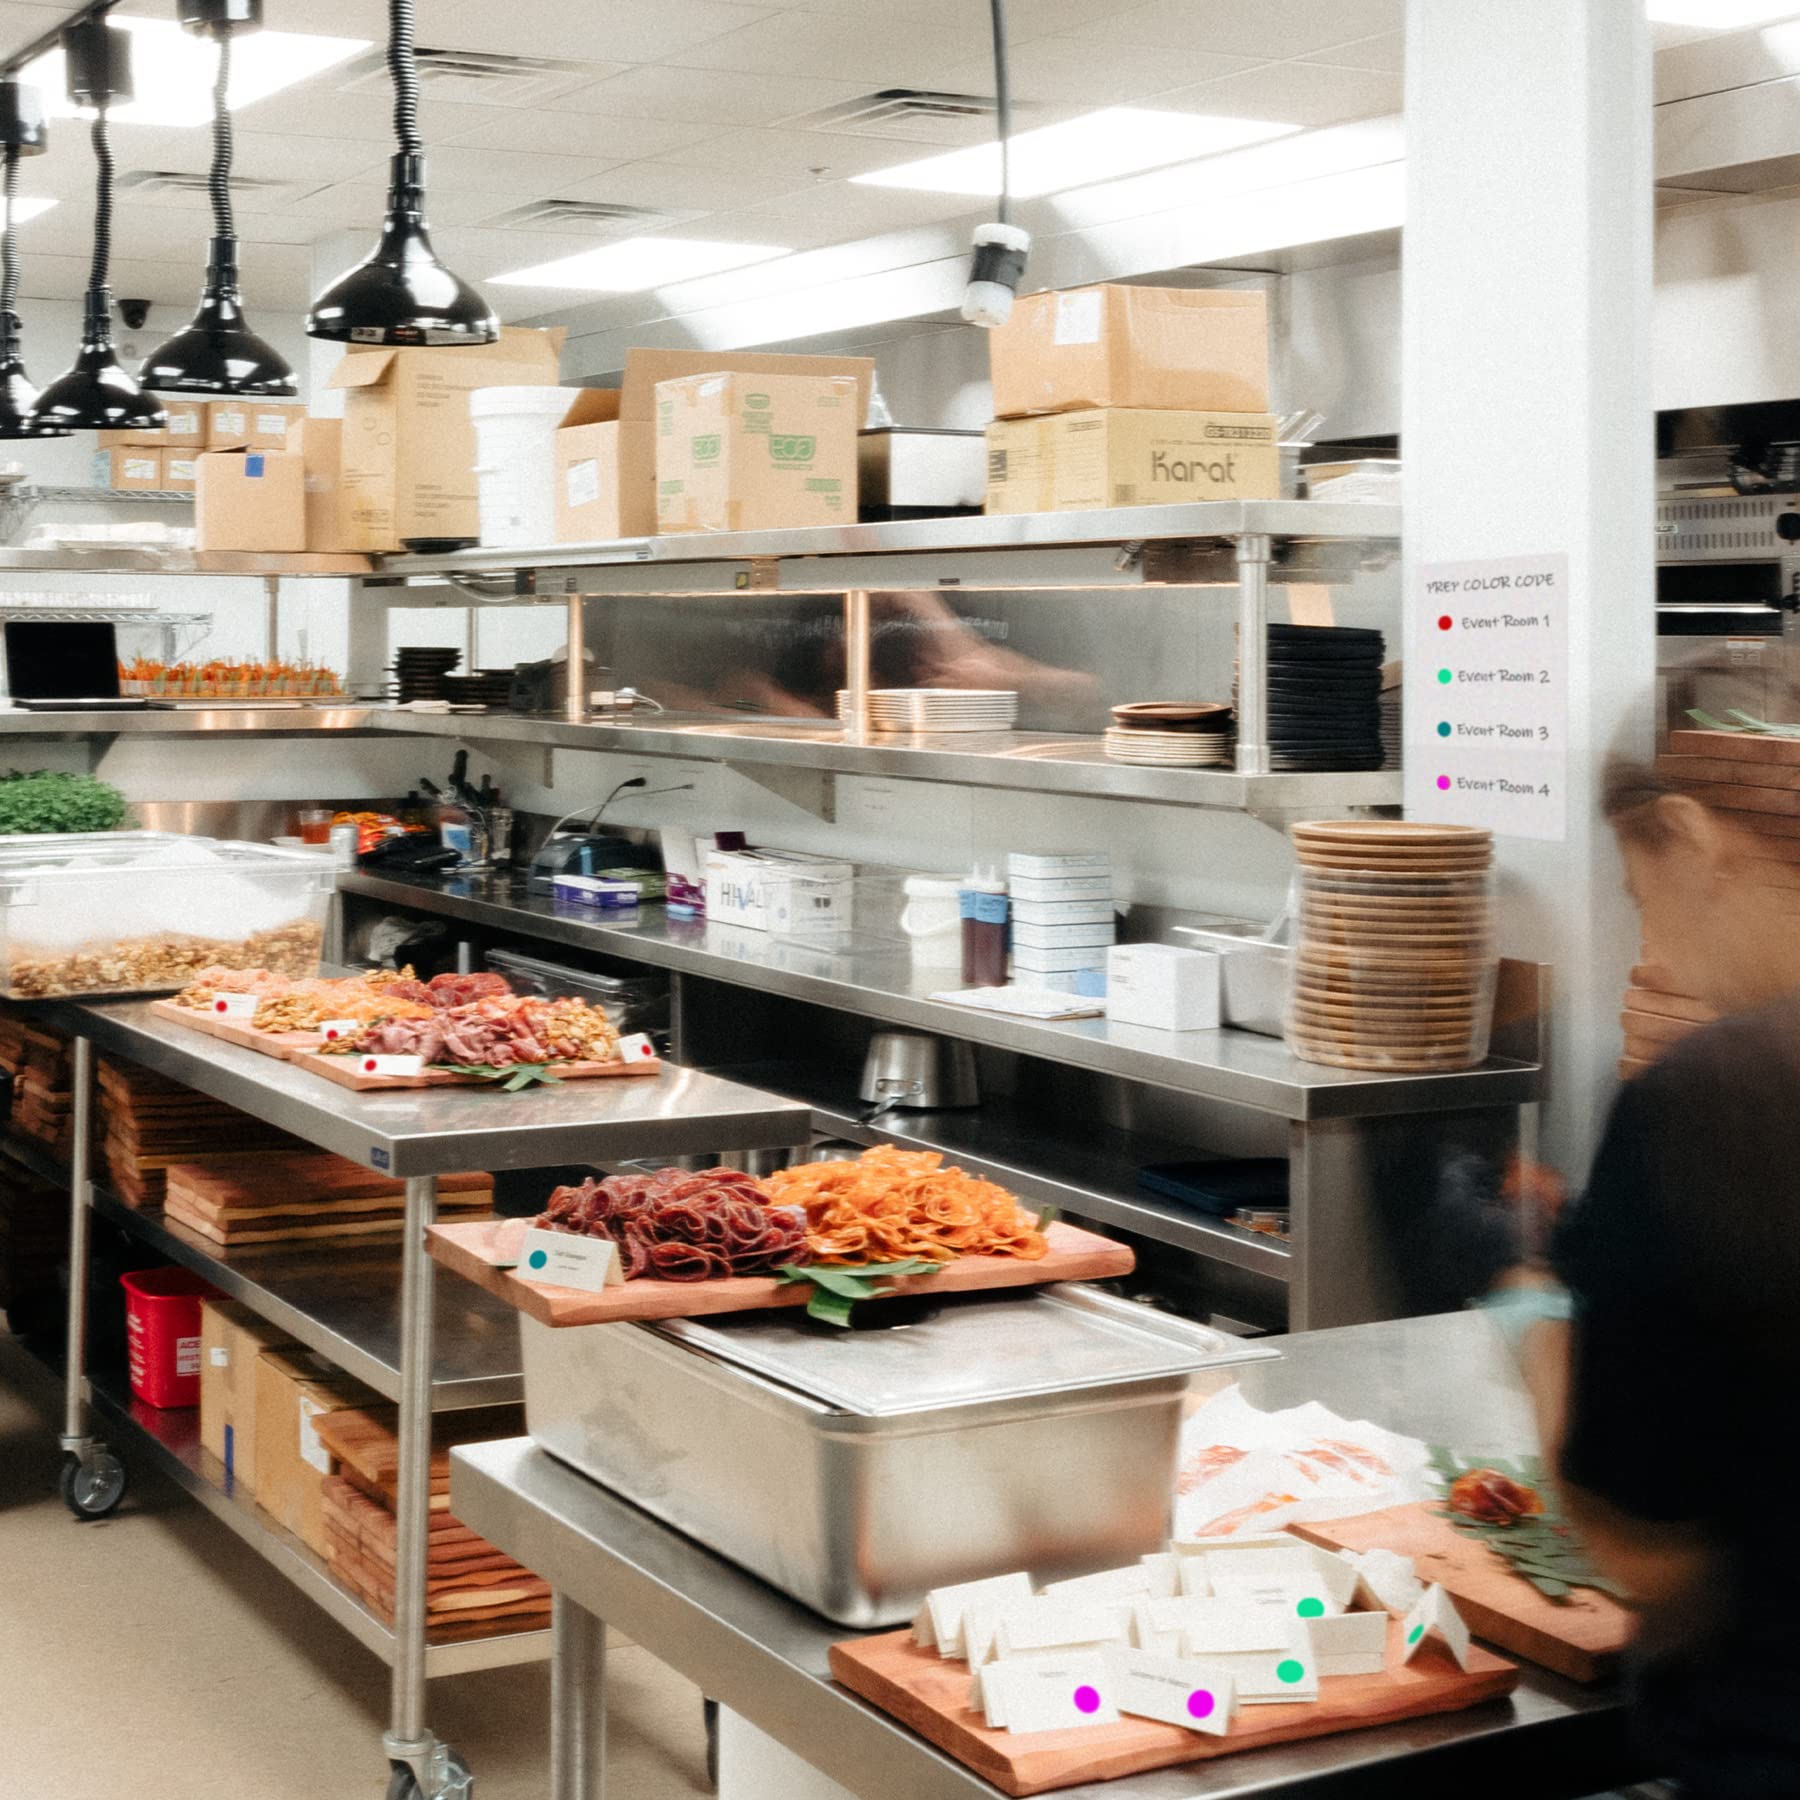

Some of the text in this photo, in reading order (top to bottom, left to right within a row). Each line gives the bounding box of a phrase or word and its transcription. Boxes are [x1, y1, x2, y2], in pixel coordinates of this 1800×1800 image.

[1151, 450, 1236, 483] Karat
[1426, 573, 1555, 594] PREP COLOR CODE
[1461, 613, 1550, 630] Event Room 1
[1457, 669, 1551, 684] Event Room 2
[1456, 723, 1549, 741] Event Room 3
[1456, 776, 1551, 797] Event Room 4
